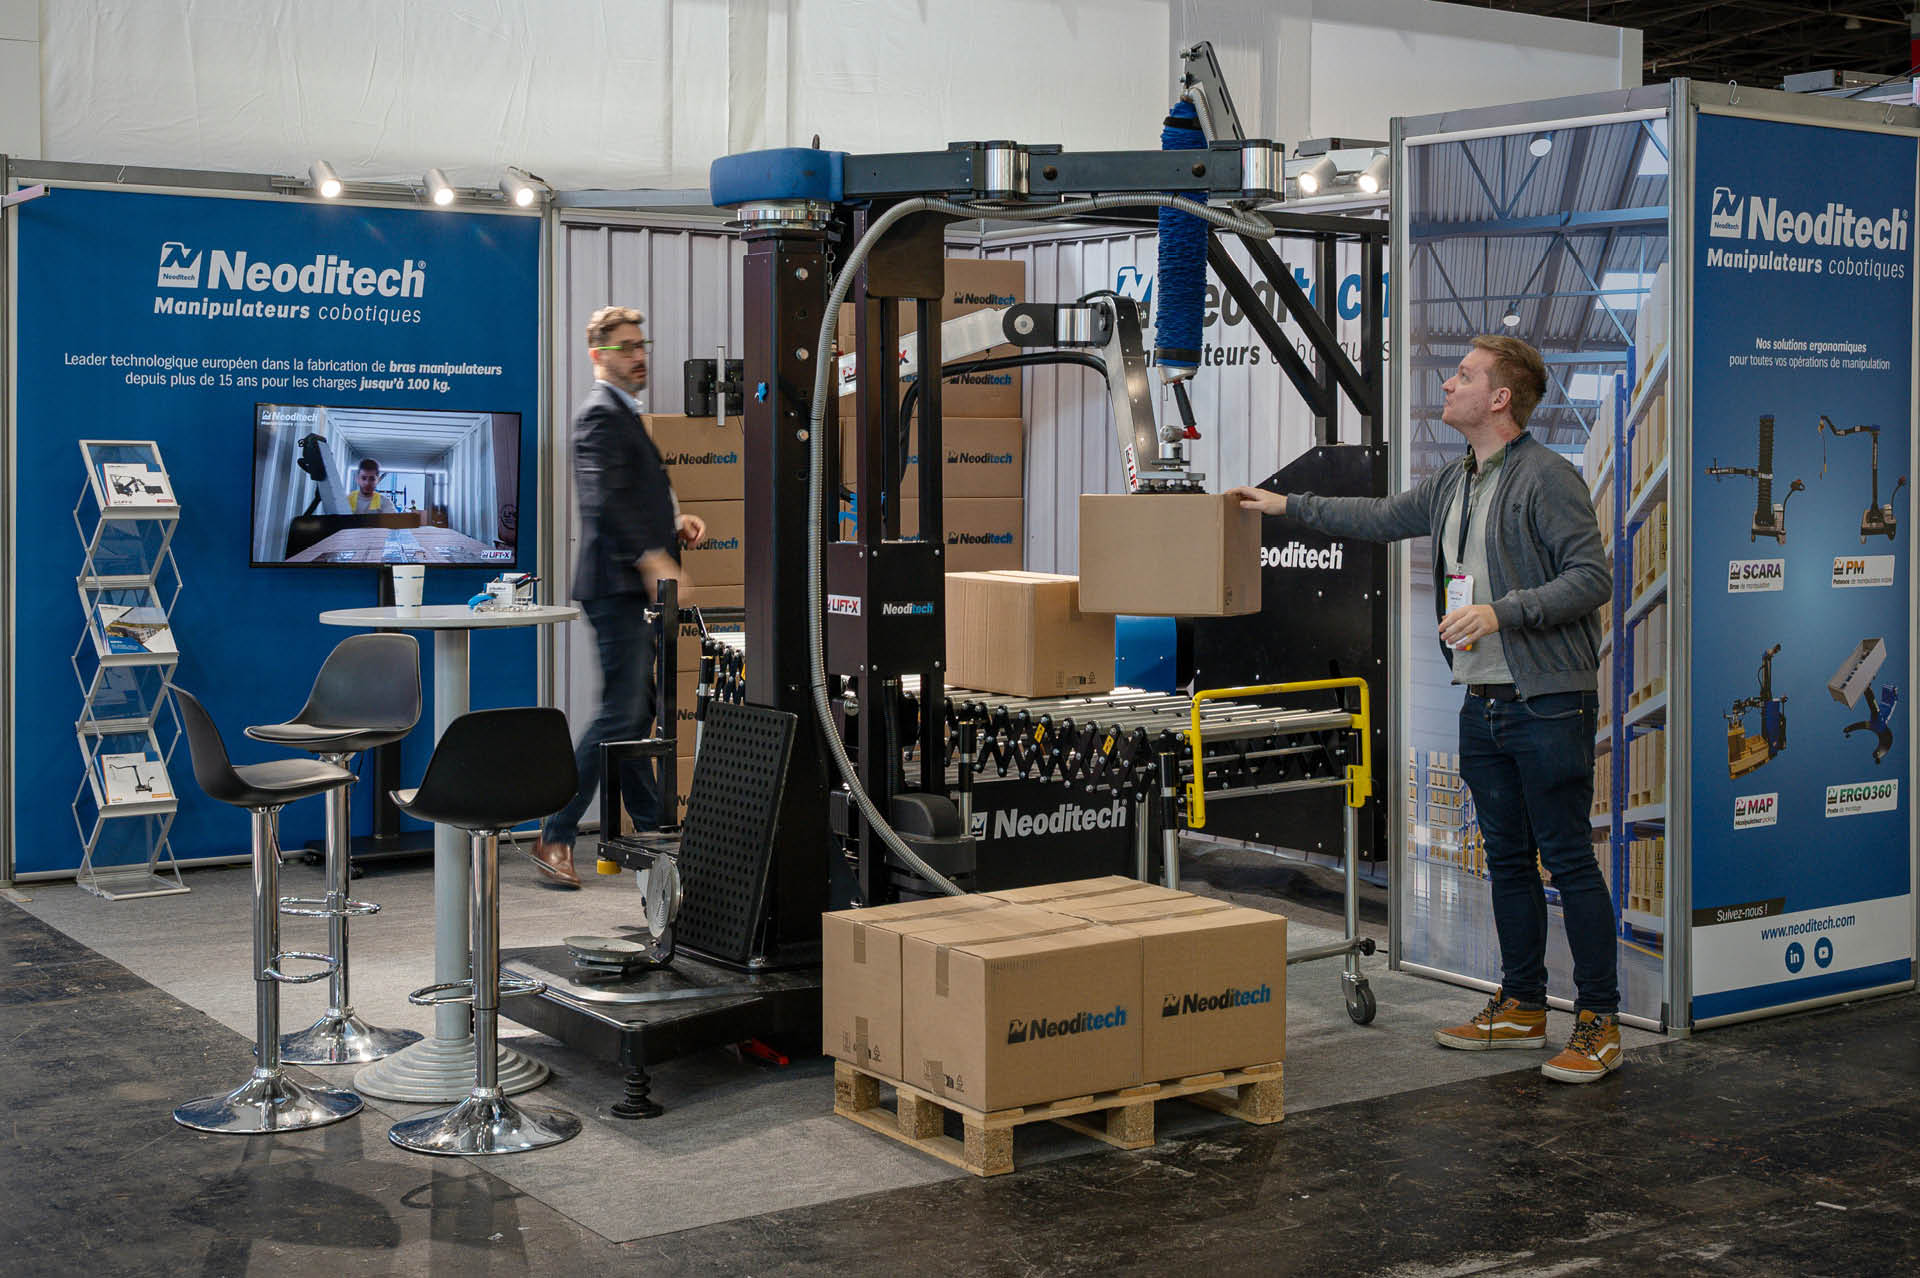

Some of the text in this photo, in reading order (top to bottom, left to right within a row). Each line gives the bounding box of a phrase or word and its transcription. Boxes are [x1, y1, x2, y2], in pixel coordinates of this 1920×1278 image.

[1706, 248, 1905, 281] Manipulateurs cobotiques
[162, 273, 195, 281] Neoditech
[964, 293, 1016, 305] Neoditech
[153, 297, 422, 325] Manipulateurs cobotiques
[1755, 337, 1867, 355] Nos solutions ergonomiques
[64, 352, 503, 376] Leader technologique européen dans la fabrication de bras manipulateurs
[1729, 355, 1891, 370] pour toutes vos opérations de manipulation
[125, 371, 167, 387] depuis
[170, 372, 196, 388] plus
[199, 373, 215, 386] de
[218, 374, 233, 386] 15
[236, 376, 258, 387] ans
[261, 376, 288, 389] pour
[292, 375, 309, 388] les
[312, 375, 358, 391] charges
[407, 378, 430, 390] 100
[432, 378, 451, 393] kg.
[961, 373, 1012, 384] Neoditech
[679, 451, 738, 465] Neoditech
[959, 452, 1013, 464] Neoditech
[960, 532, 1013, 544] Neoditech
[1260, 541, 1343, 569] eoditech
[1743, 563, 1782, 579] SCARA
[1846, 560, 1865, 575] PM
[883, 603, 934, 615] Neoditech
[1748, 797, 1773, 815] MAP
[1761, 915, 1855, 940] www.neoditech.com
[1182, 983, 1271, 1015] Neoditech
[1029, 1005, 1127, 1041] Neoditech
